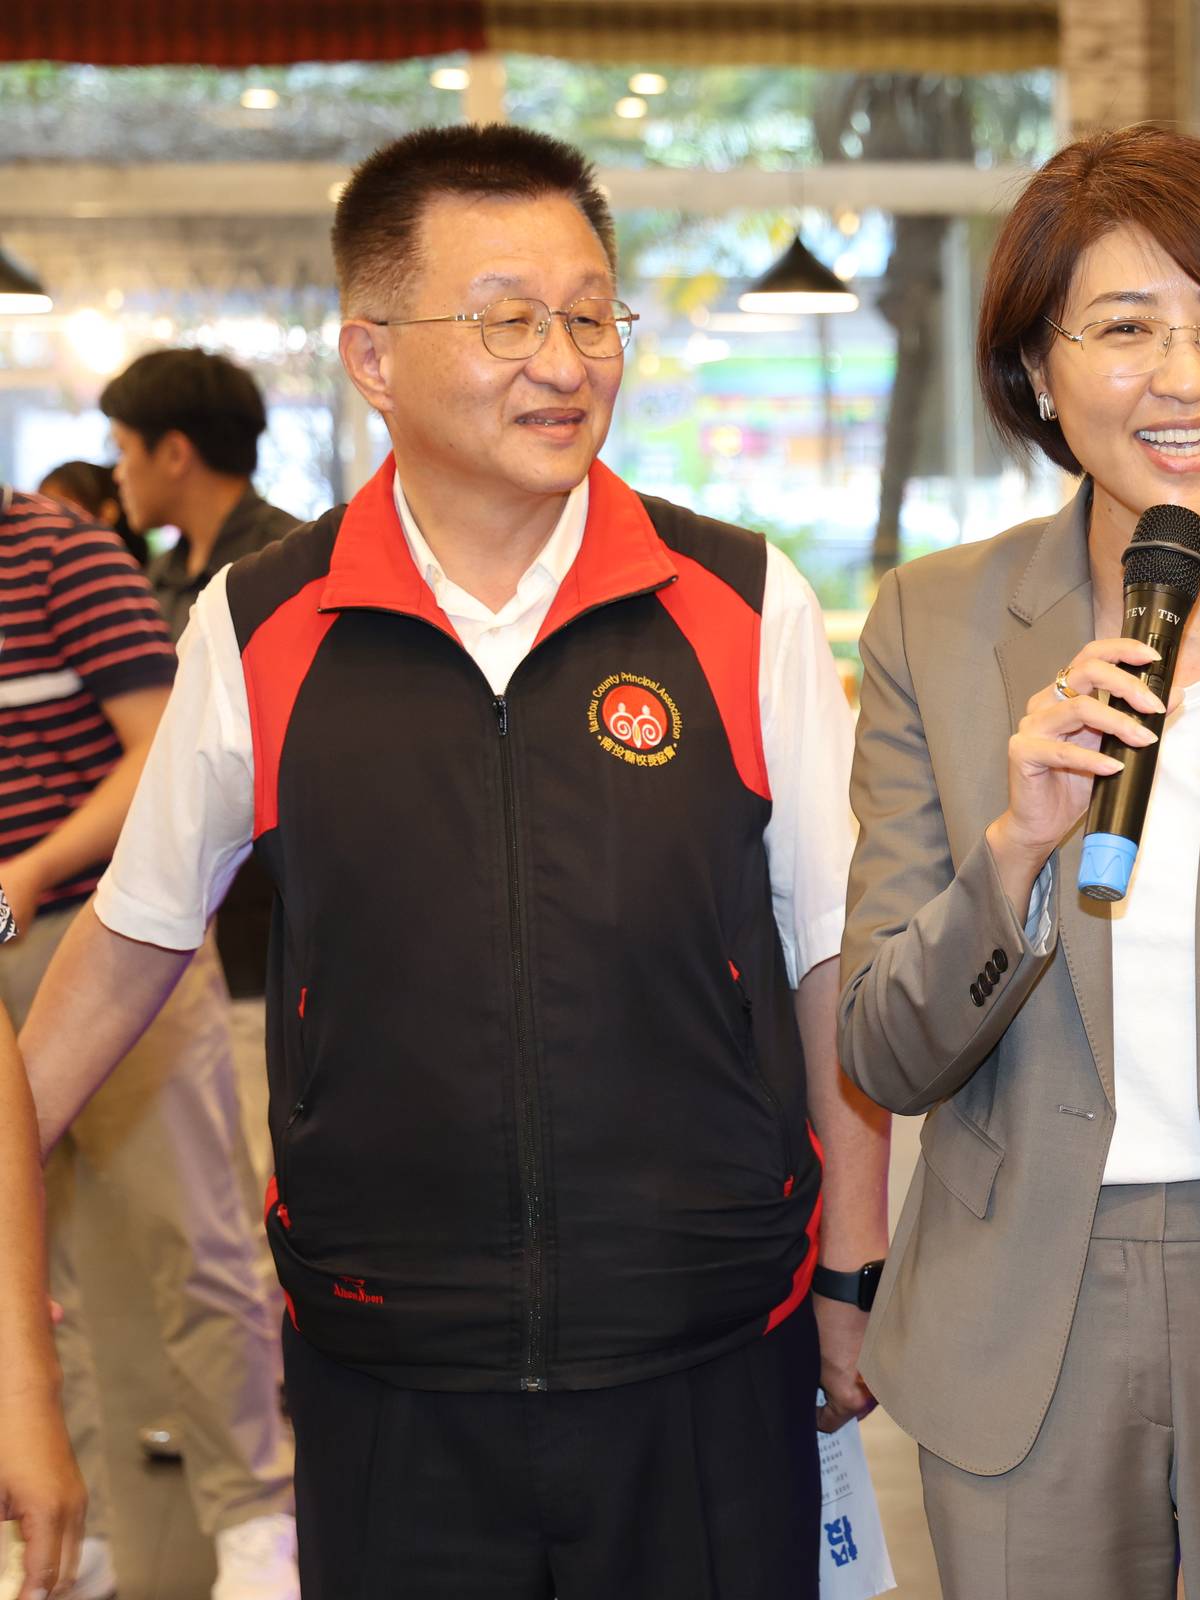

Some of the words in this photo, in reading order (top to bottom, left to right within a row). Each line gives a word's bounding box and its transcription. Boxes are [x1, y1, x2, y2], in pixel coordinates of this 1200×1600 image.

[1126, 606, 1147, 619] TEV
[1158, 608, 1181, 625] TEV
[592, 674, 620, 698] County
[658, 688, 683, 740] Association
